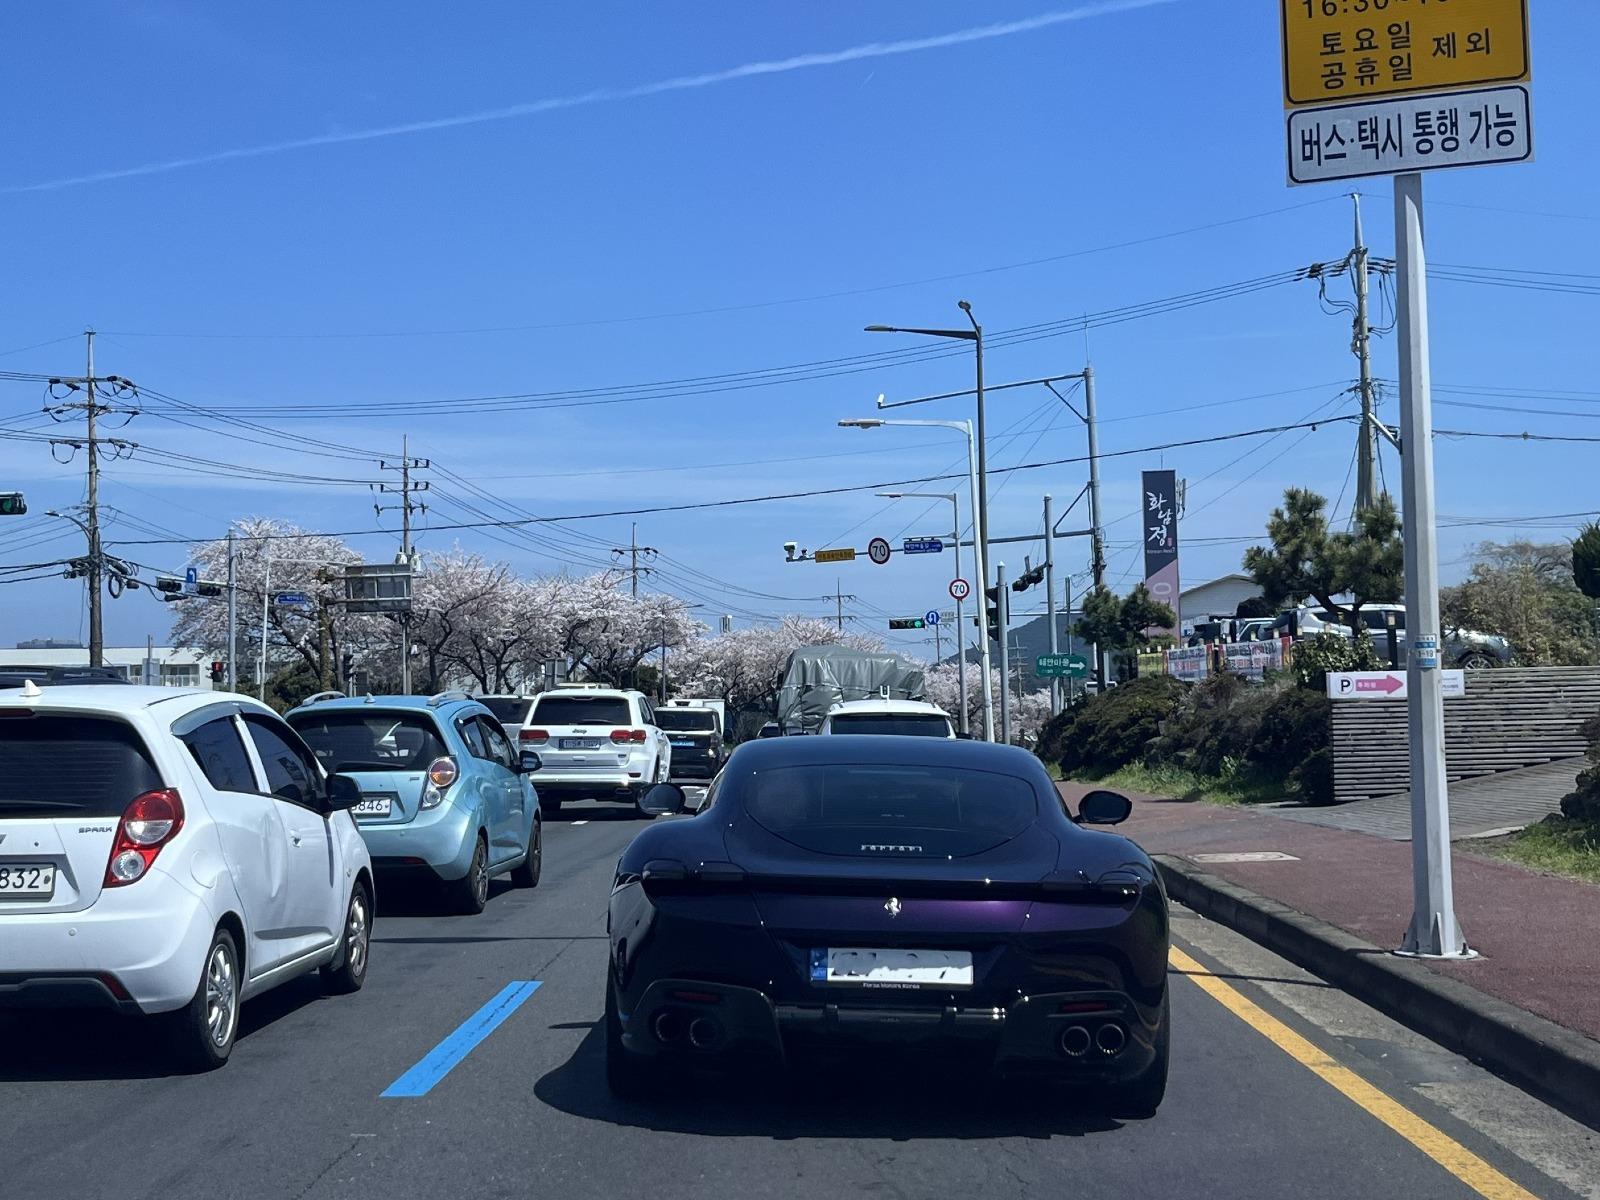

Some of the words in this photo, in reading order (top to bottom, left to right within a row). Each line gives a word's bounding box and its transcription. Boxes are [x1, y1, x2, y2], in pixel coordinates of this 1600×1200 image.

[1319, 21, 1411, 56] 토요일
[1432, 27, 1491, 59] 제외
[1320, 52, 1413, 90] 공휴일
[1412, 107, 1460, 155] 통행
[1469, 103, 1517, 149] 가능
[872, 544, 886, 558] 70
[953, 584, 965, 595] 70
[1340, 679, 1351, 692] P
[351, 799, 383, 811] 846
[78, 825, 113, 834] SPARK
[0, 867, 41, 889] 832
